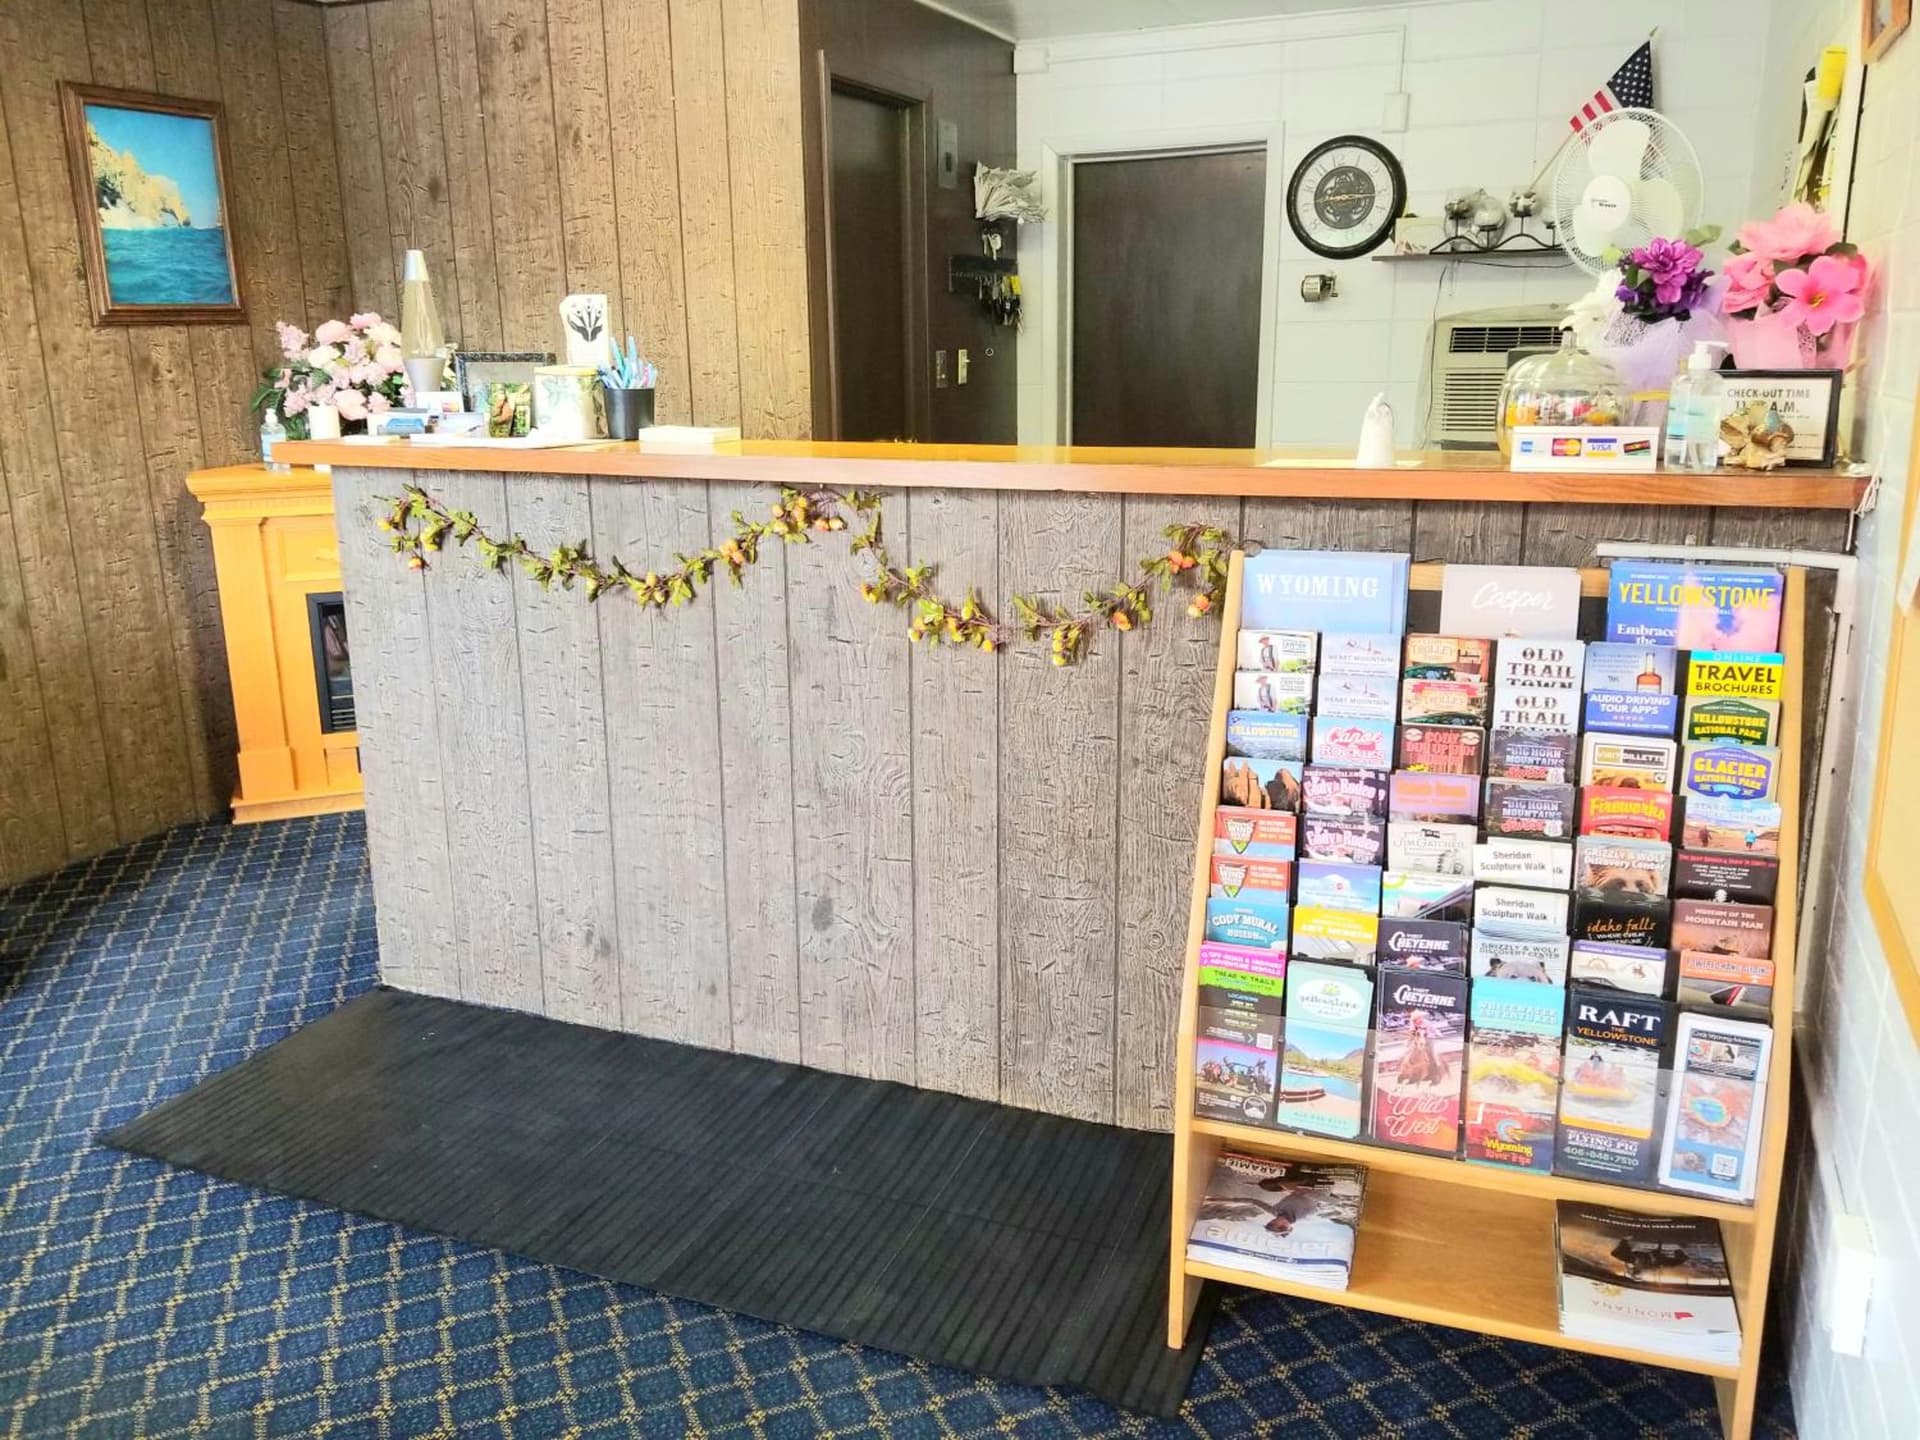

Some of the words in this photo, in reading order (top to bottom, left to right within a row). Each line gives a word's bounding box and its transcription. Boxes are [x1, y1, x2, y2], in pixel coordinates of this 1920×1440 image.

[1727, 388, 1784, 399] CHECK-OUT
[1785, 389, 1812, 399] TIME
[1256, 573, 1380, 599] WYOMING
[1472, 581, 1553, 616] Casper
[1619, 581, 1776, 612] YELLOWSTONE
[1521, 647, 1564, 662] OLD
[1507, 662, 1576, 679] TRAIL
[1695, 664, 1777, 684] TRAVEL
[1695, 683, 1773, 695] BROCHURES
[1515, 695, 1558, 709] OLD
[1590, 693, 1624, 704] AUDIO
[1626, 695, 1671, 706] DRIVING
[1500, 709, 1570, 726] TRAIL
[1600, 703, 1629, 714] TOUR
[1631, 705, 1660, 715] APPS
[1693, 713, 1768, 727] YELLOWSTONE
[1694, 726, 1734, 736] NATIONAL
[1735, 729, 1763, 739] PARK
[1505, 756, 1566, 768] MOUNTAINS
[1694, 757, 1767, 779] GLACIER
[1492, 851, 1532, 860] Sheridan
[1480, 862, 1521, 873] Sculpture
[1524, 863, 1547, 871] Walk
[1495, 898, 1535, 908] Sheridan
[1481, 908, 1523, 920] Sculpture
[1525, 912, 1548, 921] Walk
[1685, 915, 1739, 927] MOUNTAIN
[1740, 920, 1764, 930] MAN
[1212, 914, 1242, 928] CODY
[1241, 914, 1279, 935] MURAL
[1587, 918, 1622, 933] idaho
[1626, 916, 1656, 933] falls
[1388, 931, 1451, 952] CHEYENNE
[1393, 984, 1457, 1008] CHEYENNE
[1578, 1004, 1661, 1032] RAFT
[1577, 1026, 1660, 1047] YELLOWSTONE
[1387, 1092, 1449, 1115] Wild
[1384, 1115, 1449, 1138] West
[1485, 1136, 1533, 1157] Wyoming
